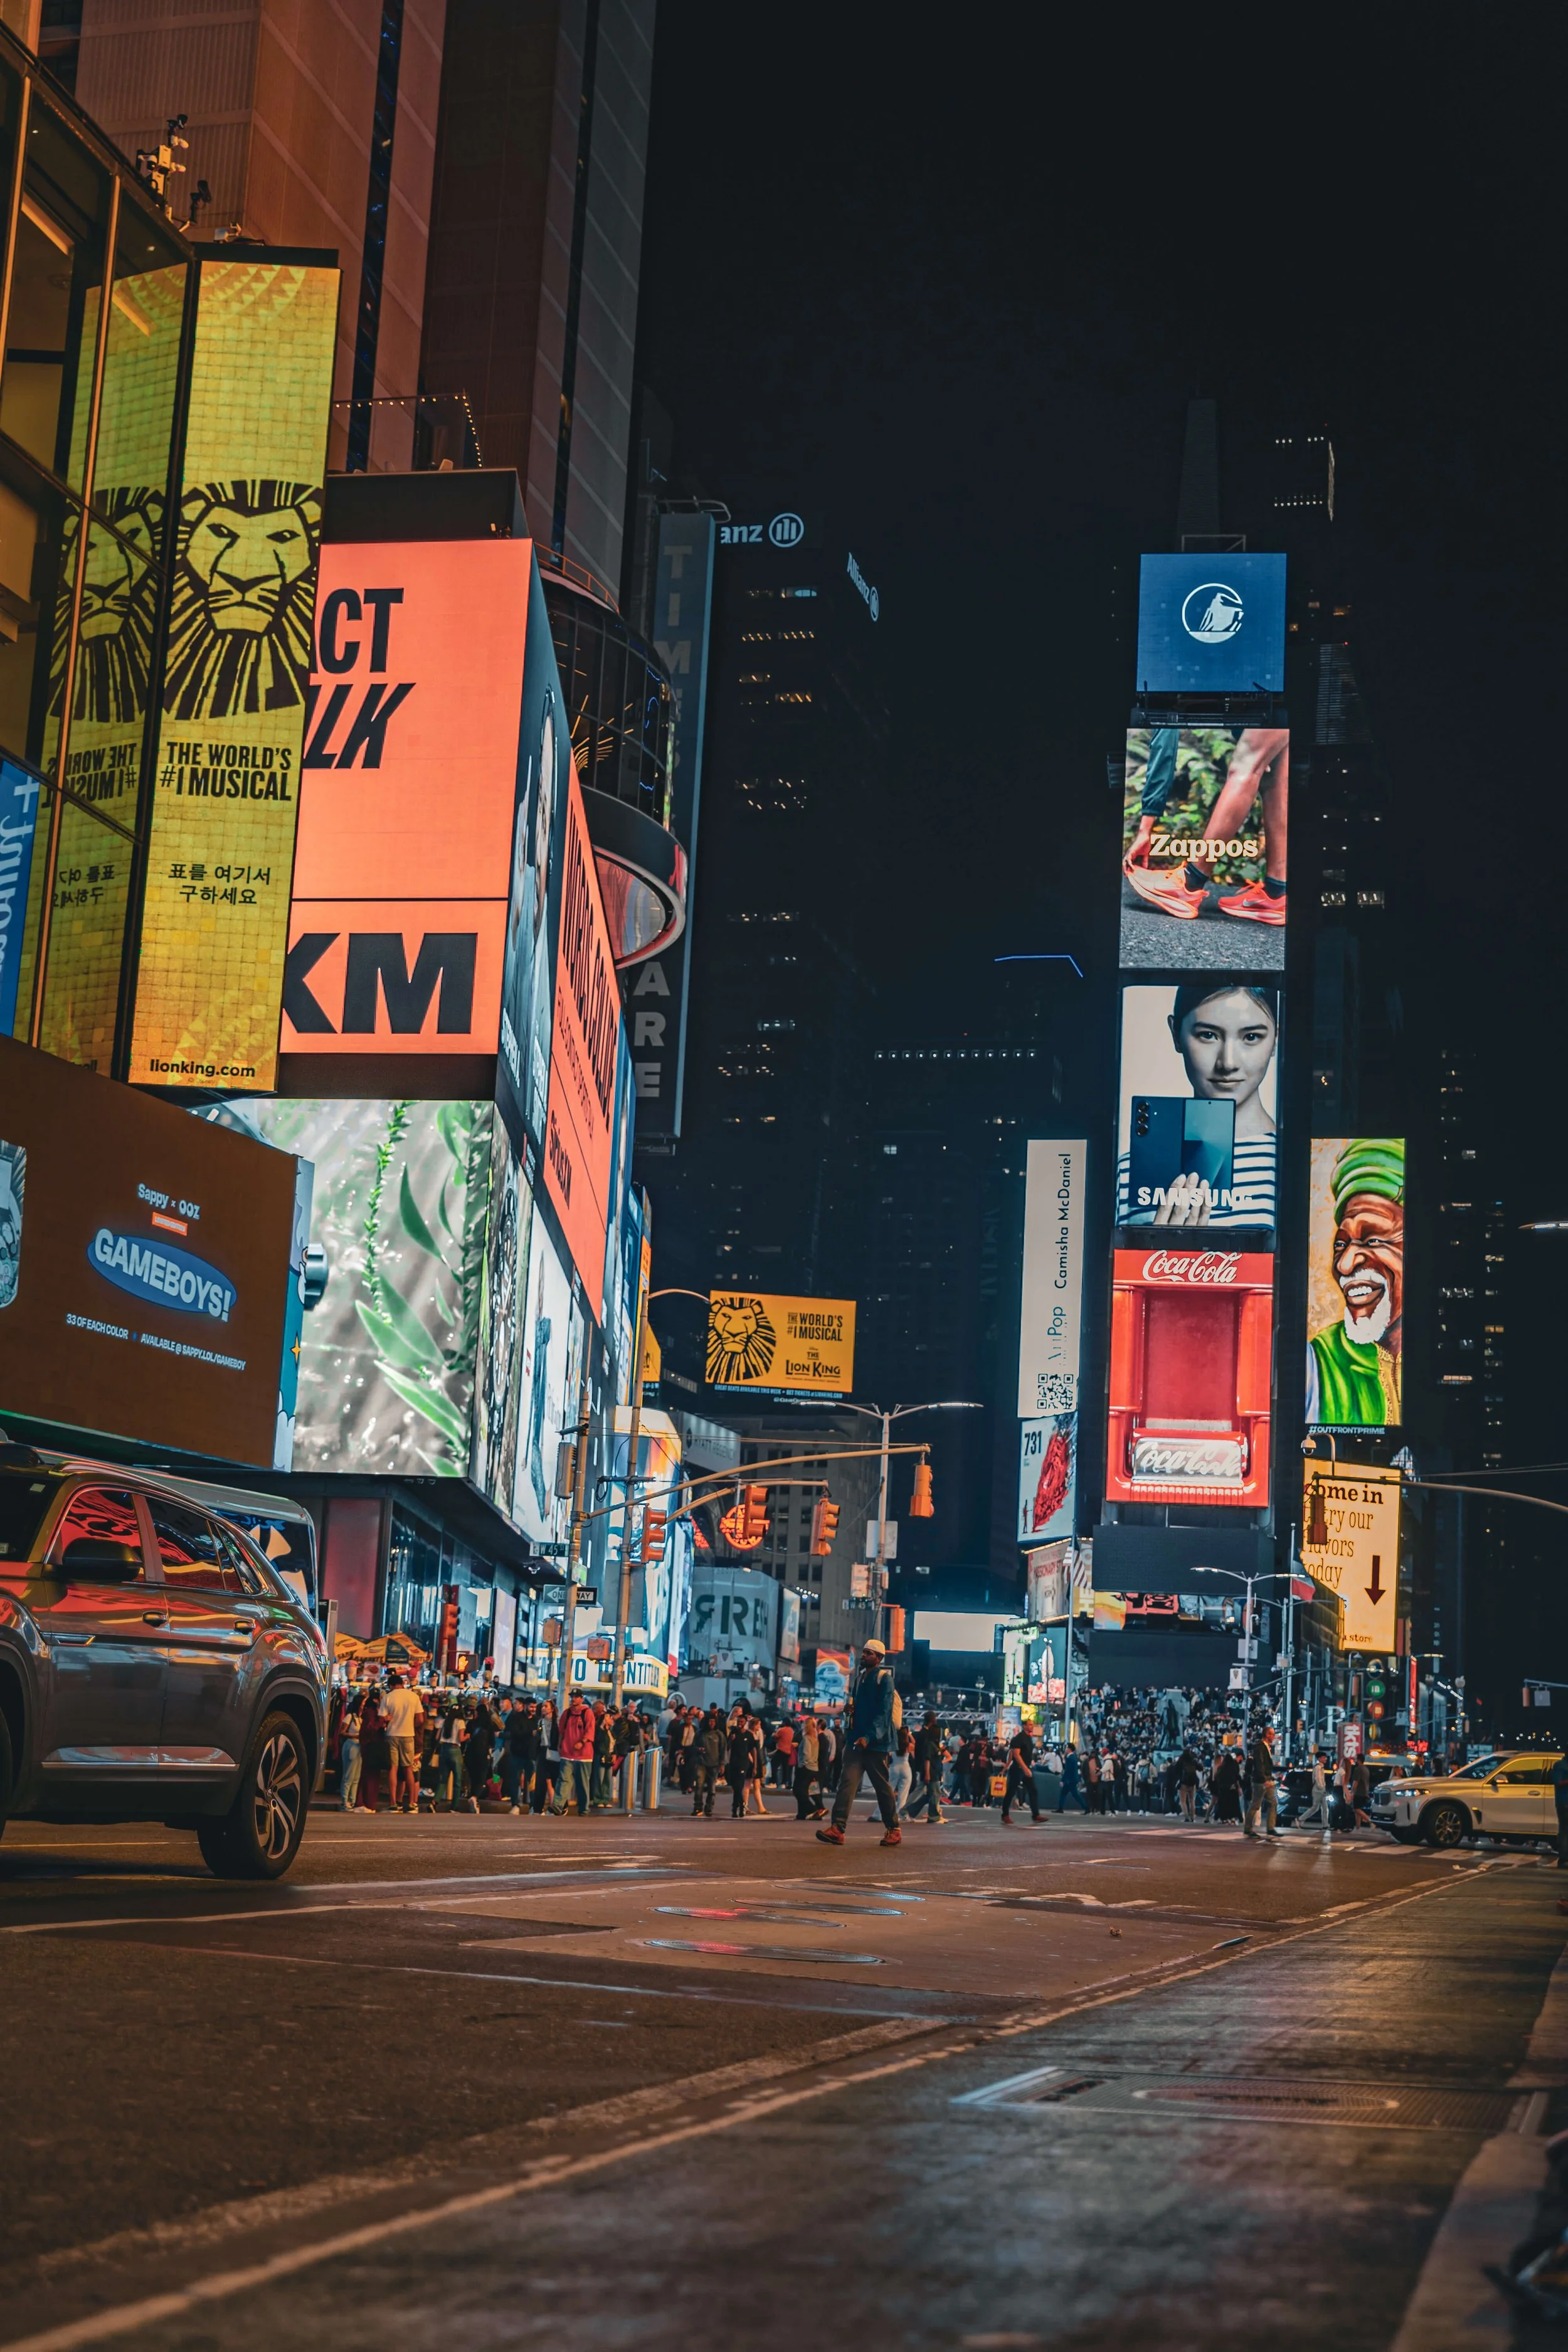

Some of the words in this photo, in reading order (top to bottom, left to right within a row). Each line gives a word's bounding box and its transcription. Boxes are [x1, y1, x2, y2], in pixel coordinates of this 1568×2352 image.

[847, 552, 871, 605] Allianz
[311, 587, 405, 674] CT
[303, 682, 416, 770] LK
[166, 741, 203, 764] THE
[208, 743, 292, 771] WORLD'S
[188, 768, 292, 802] MUSICAL
[1149, 834, 1259, 862] Zappos
[168, 864, 207, 882] 표를
[215, 866, 272, 885] 여기서
[179, 885, 257, 905] 구하세요
[562, 799, 593, 1042] WORDS
[587, 937, 617, 1133] COLLIDE
[632, 961, 671, 1098] ARE
[150, 1059, 255, 1077] lionking.com
[137, 1183, 169, 1209] Sappy
[1057, 1153, 1071, 1221] McDaniel
[1137, 1187, 1253, 1207] SAMSUNG
[1054, 1227, 1069, 1289] Camisha
[1142, 1250, 1242, 1283] Coca-Cola
[95, 1227, 232, 1323] GAMEBOYS!
[66, 1313, 77, 1325] 33
[77, 1316, 88, 1329] OF
[87, 1320, 106, 1334] EACH
[106, 1325, 129, 1340] COLOR
[140, 1333, 176, 1352] AVAILABLE
[788, 1313, 797, 1322] THE
[800, 1313, 843, 1328] WORLD'S
[799, 1326, 843, 1342] MUSICAL
[1024, 1429, 1042, 1456] 731
[1308, 1426, 1385, 1434] #OUTFRONTPRIME
[1362, 1484, 1384, 1505] in
[1349, 1512, 1374, 1530] our
[541, 1544, 546, 1555] W
[548, 1545, 558, 1555] 45
[1344, 1725, 1360, 1759] tkts
